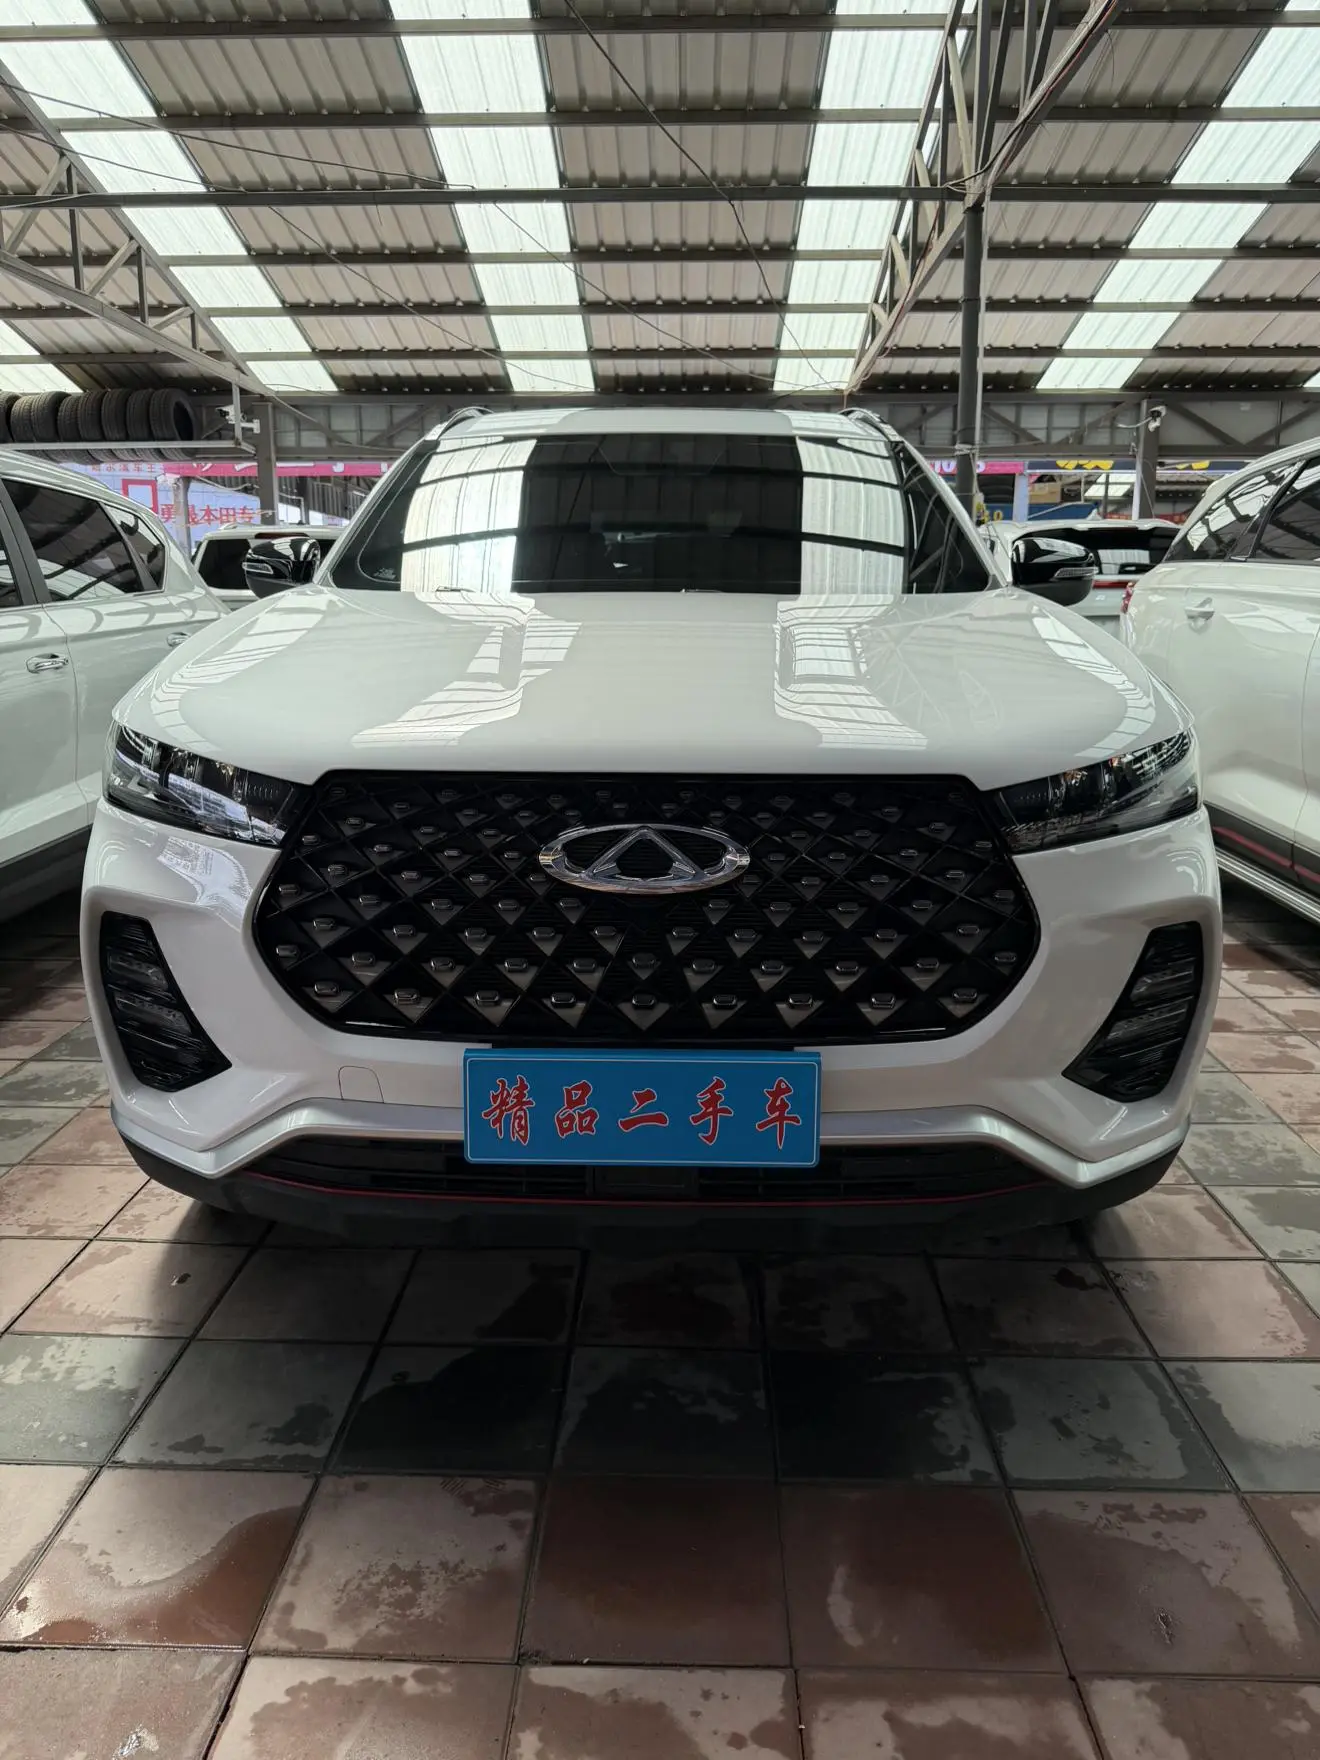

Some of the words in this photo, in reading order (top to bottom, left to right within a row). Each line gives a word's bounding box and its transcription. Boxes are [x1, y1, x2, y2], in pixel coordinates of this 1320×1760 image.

[481, 1075, 802, 1149] 精品二手车
